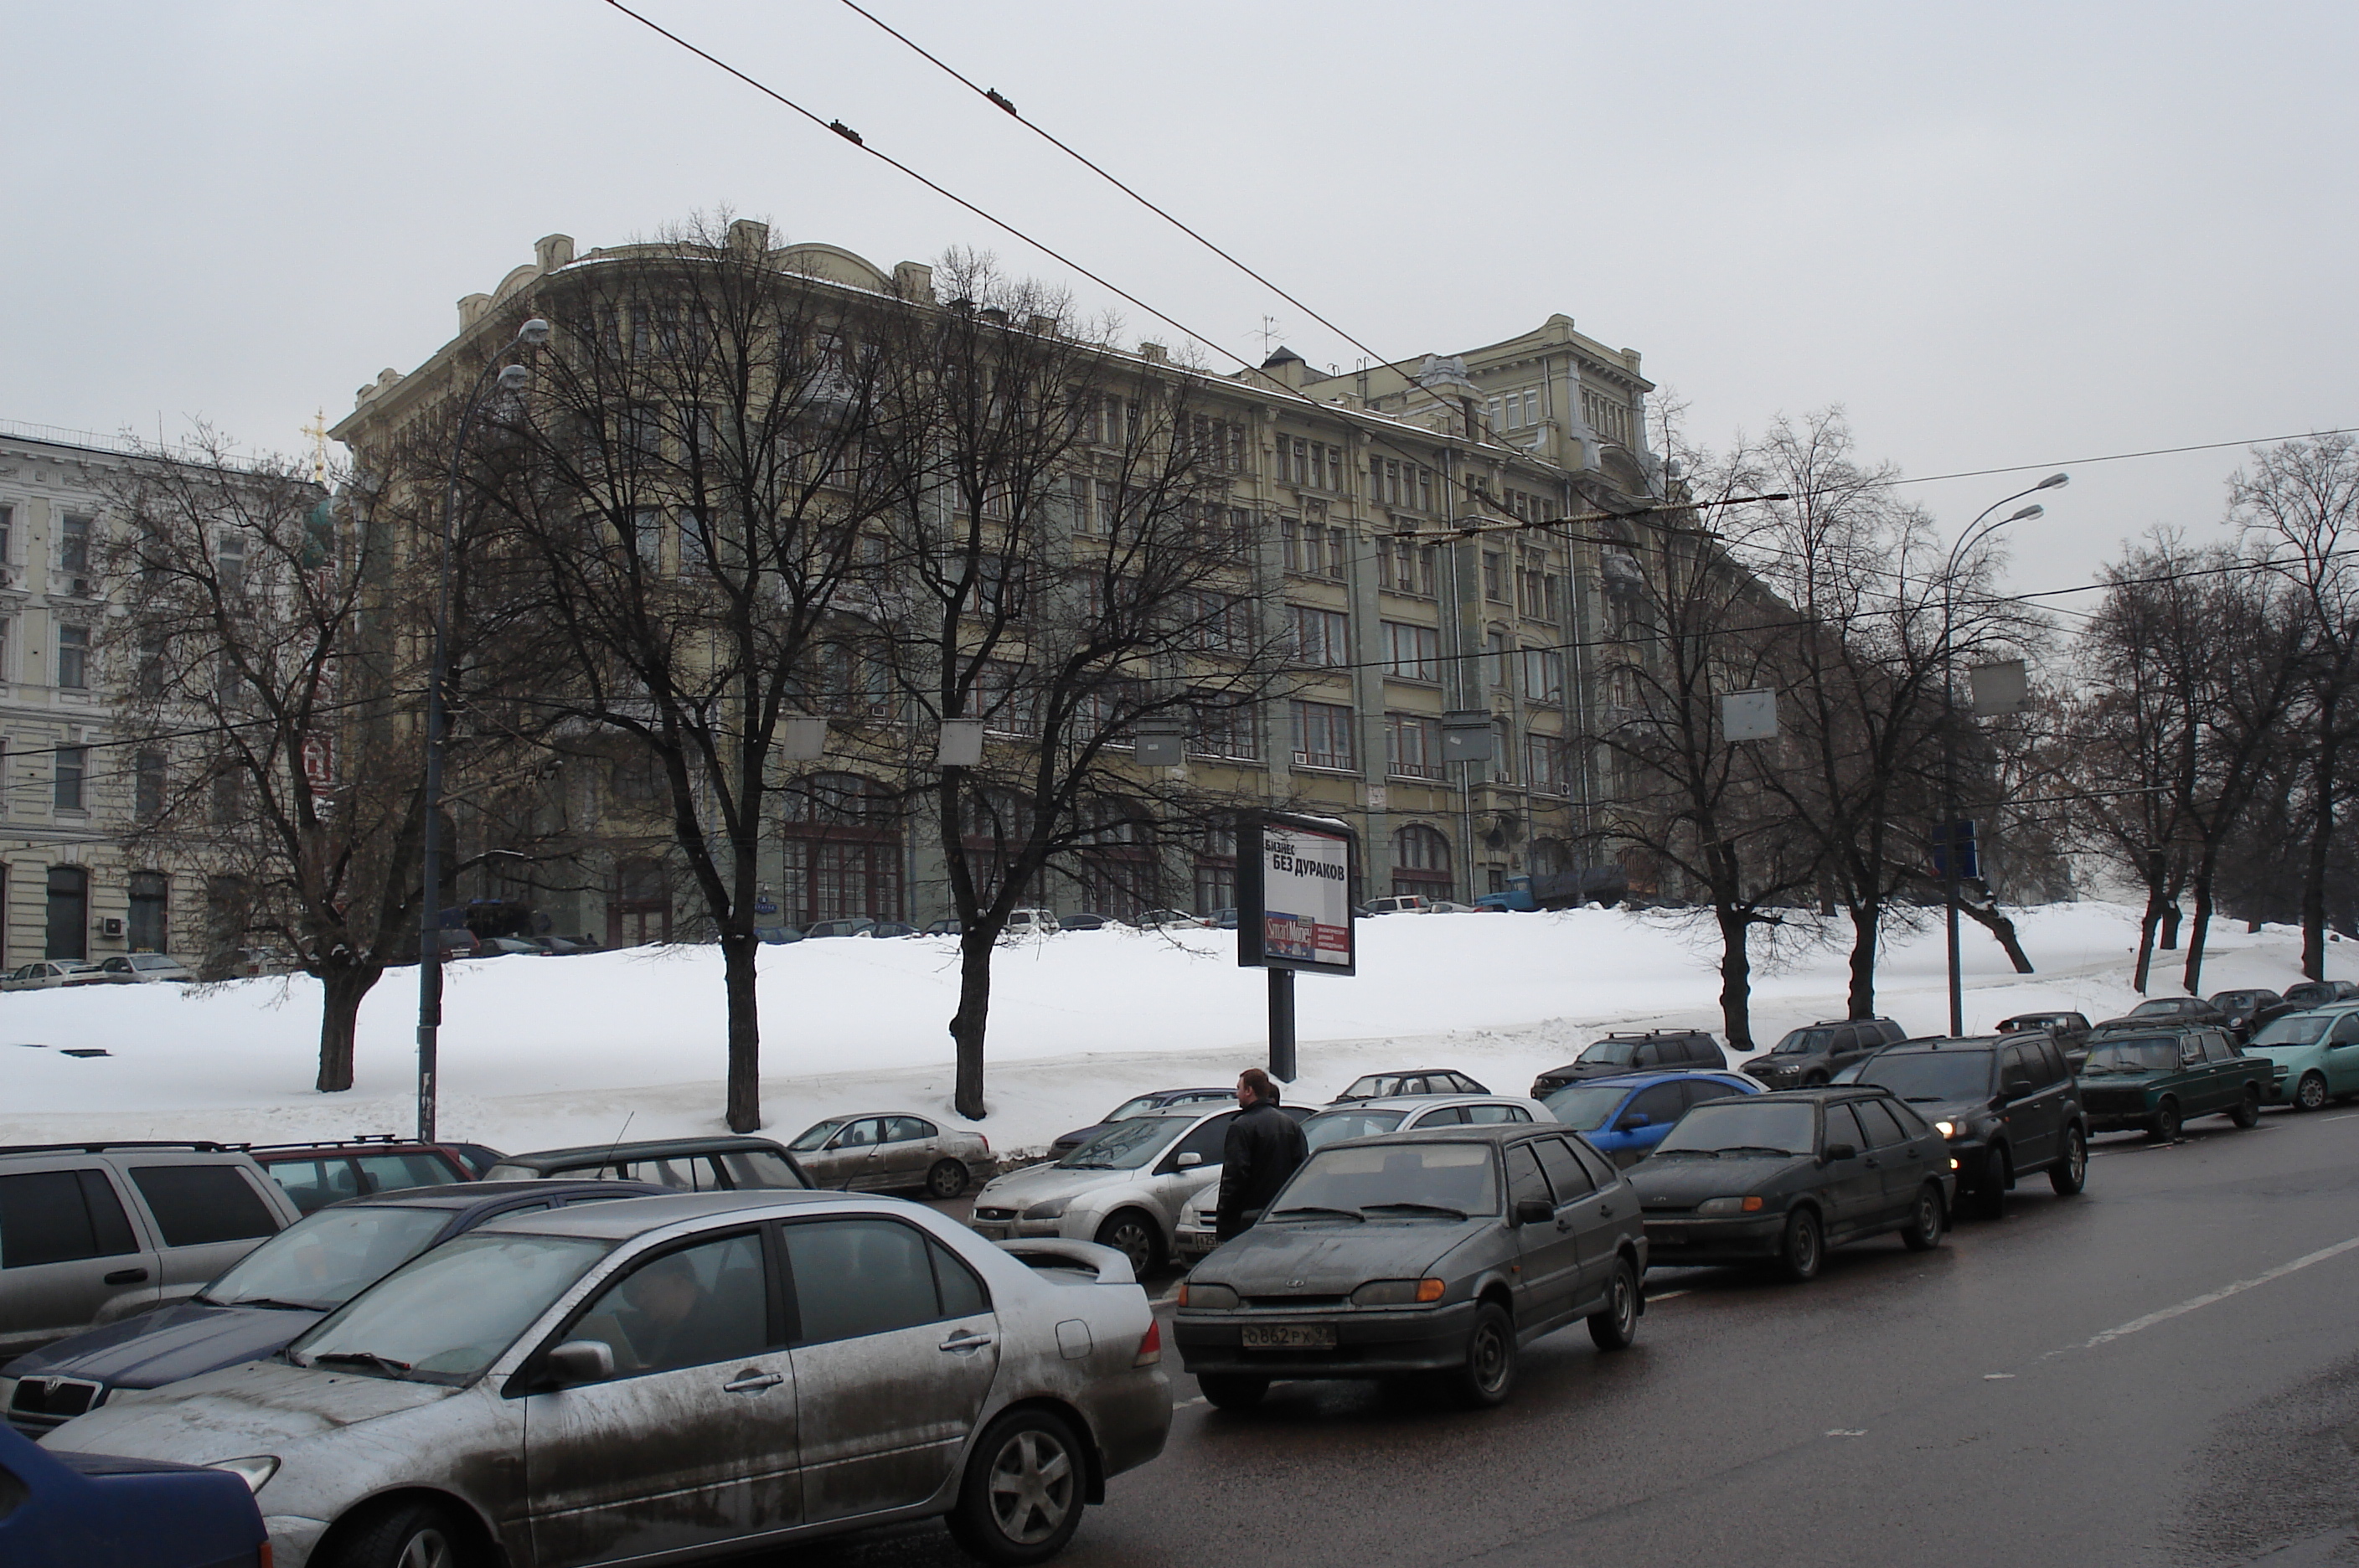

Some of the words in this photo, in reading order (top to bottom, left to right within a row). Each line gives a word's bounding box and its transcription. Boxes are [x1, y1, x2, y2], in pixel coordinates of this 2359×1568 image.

[1265, 839, 1295, 855] БИЗНЕС
[1273, 854, 1293, 872] БЕЗ
[1294, 858, 1345, 881] ДУРАКОВ
[1267, 918, 1313, 944] SmartMoney
